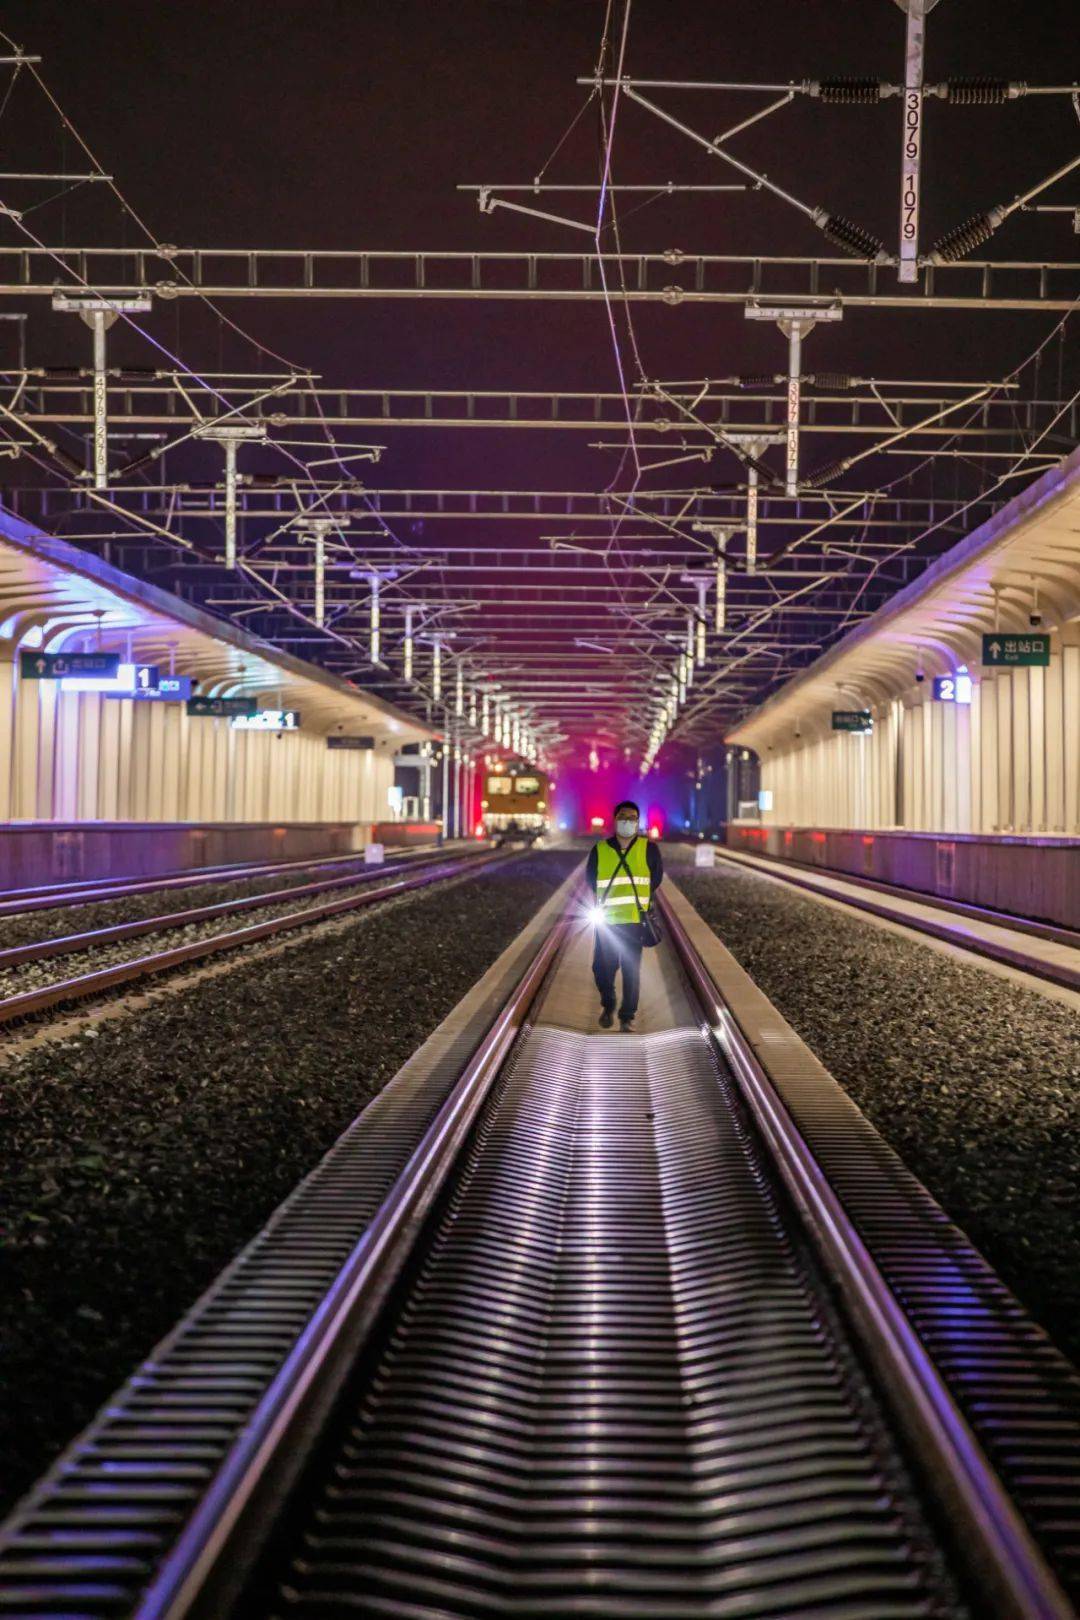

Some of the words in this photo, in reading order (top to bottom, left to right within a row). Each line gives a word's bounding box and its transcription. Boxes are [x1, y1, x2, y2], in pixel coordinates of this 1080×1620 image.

[906, 93, 919, 159] 3079
[904, 175, 916, 239] 1079
[1004, 640, 1044, 653] 出站口
[138, 668, 149, 688] 1
[940, 679, 954, 699] 2
